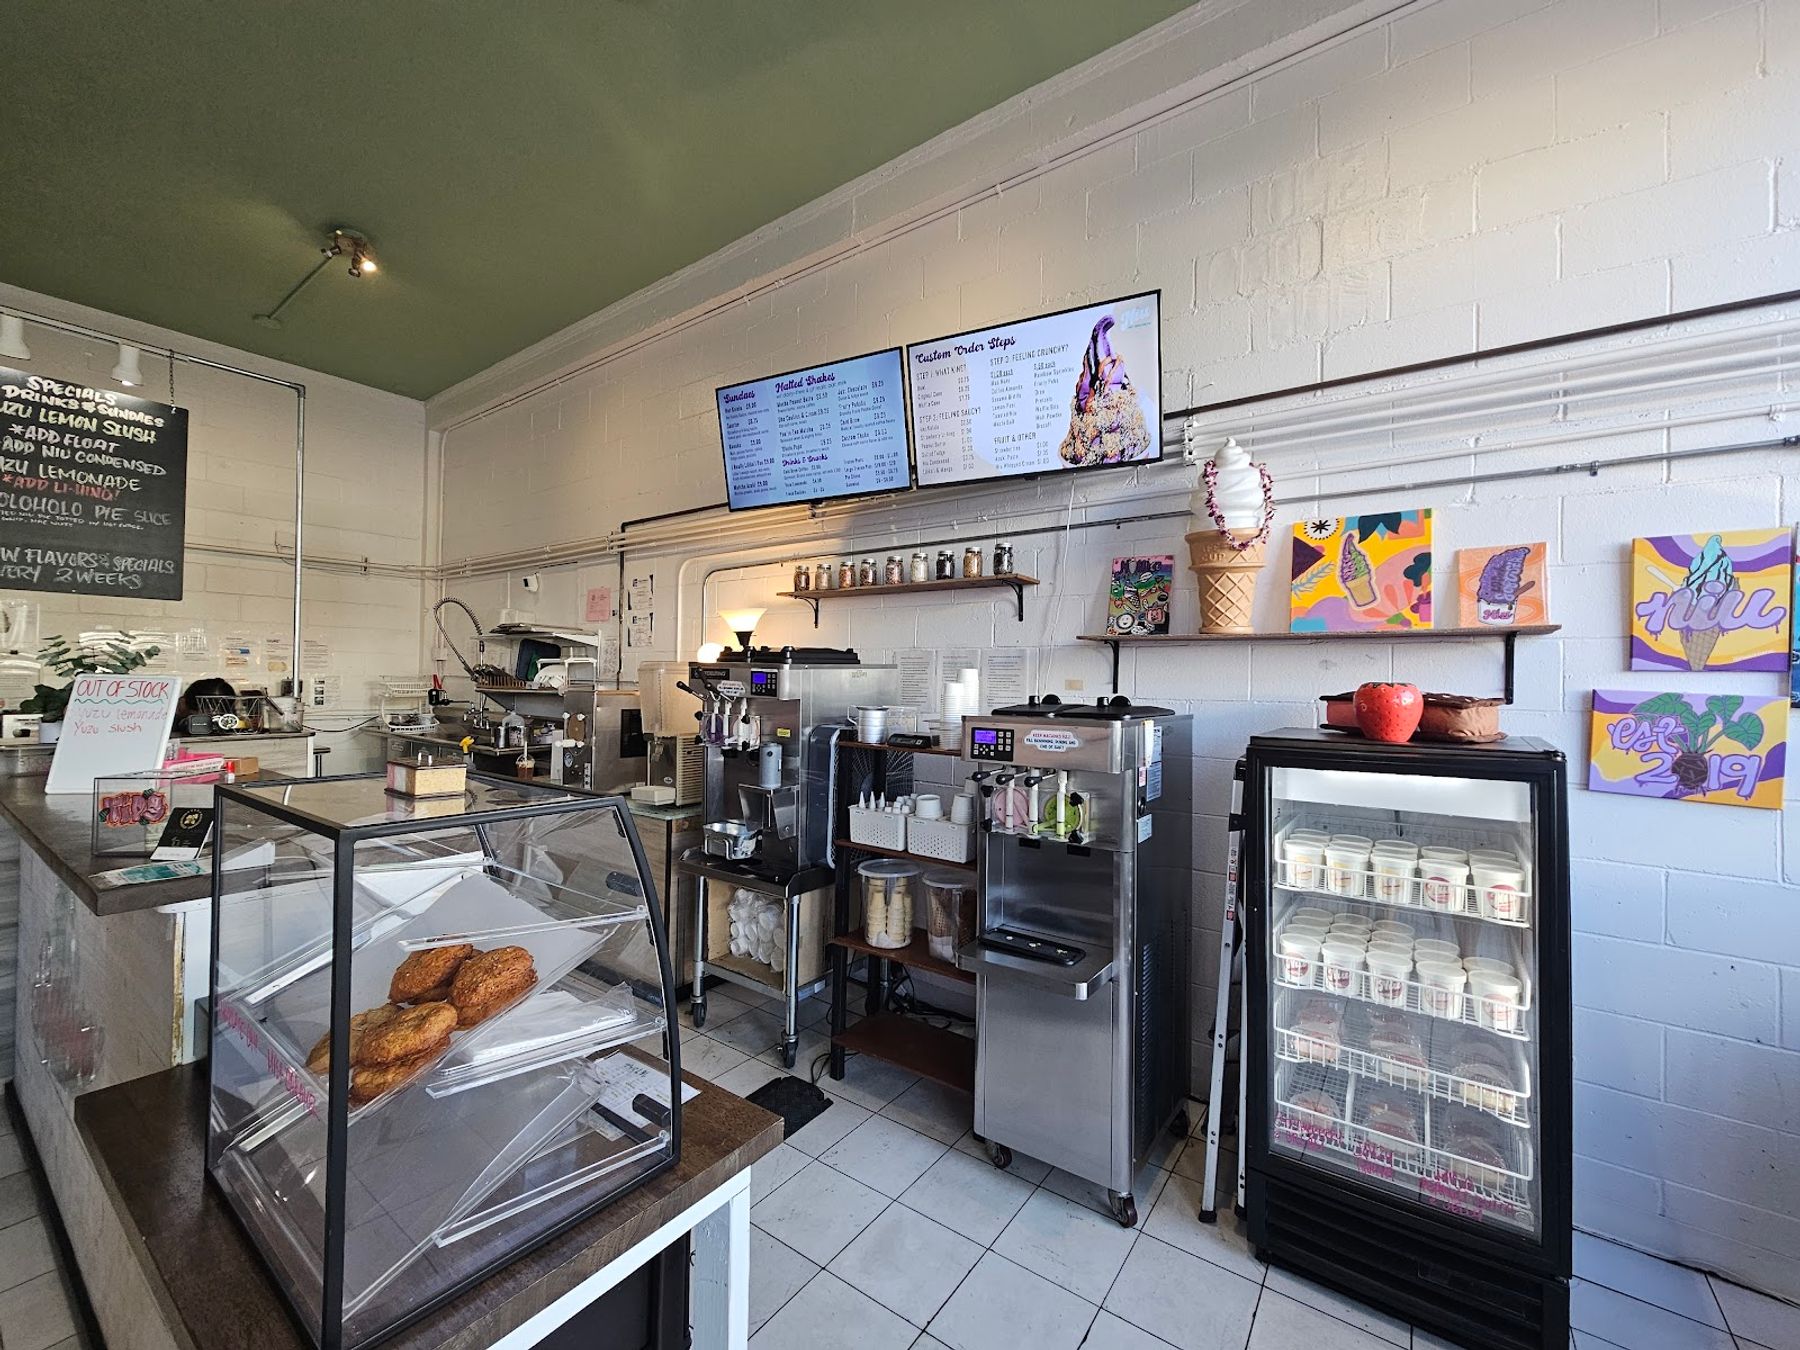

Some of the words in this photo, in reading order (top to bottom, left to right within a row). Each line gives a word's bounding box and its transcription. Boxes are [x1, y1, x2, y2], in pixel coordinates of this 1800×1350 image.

[915, 349, 951, 364] Custom
[954, 342, 985, 356] Order
[988, 336, 1016, 350] Steps
[27, 376, 117, 406] SPECIALS
[805, 372, 836, 386] Shakes
[1, 384, 80, 412] DRINKS
[97, 405, 165, 429] SUNDAES
[723, 390, 755, 404] Sundaes
[39, 408, 97, 433] LEMON
[102, 418, 158, 445] SLUSH
[63, 432, 121, 455] FLOAT
[42, 444, 72, 461] NIU
[74, 450, 167, 476] CONDENSED
[39, 462, 142, 491] LEMONADE
[94, 505, 128, 523] PIE
[133, 508, 173, 527] SLICE
[24, 548, 99, 569] FLAVORS
[112, 556, 176, 575] SPECIALS
[52, 568, 73, 585] 2
[76, 569, 144, 590] WEEKS
[76, 680, 107, 697] OUT
[106, 680, 127, 698] OF
[126, 680, 169, 699] STOCK
[74, 721, 99, 736] Yuzu
[1608, 714, 1686, 756] est
